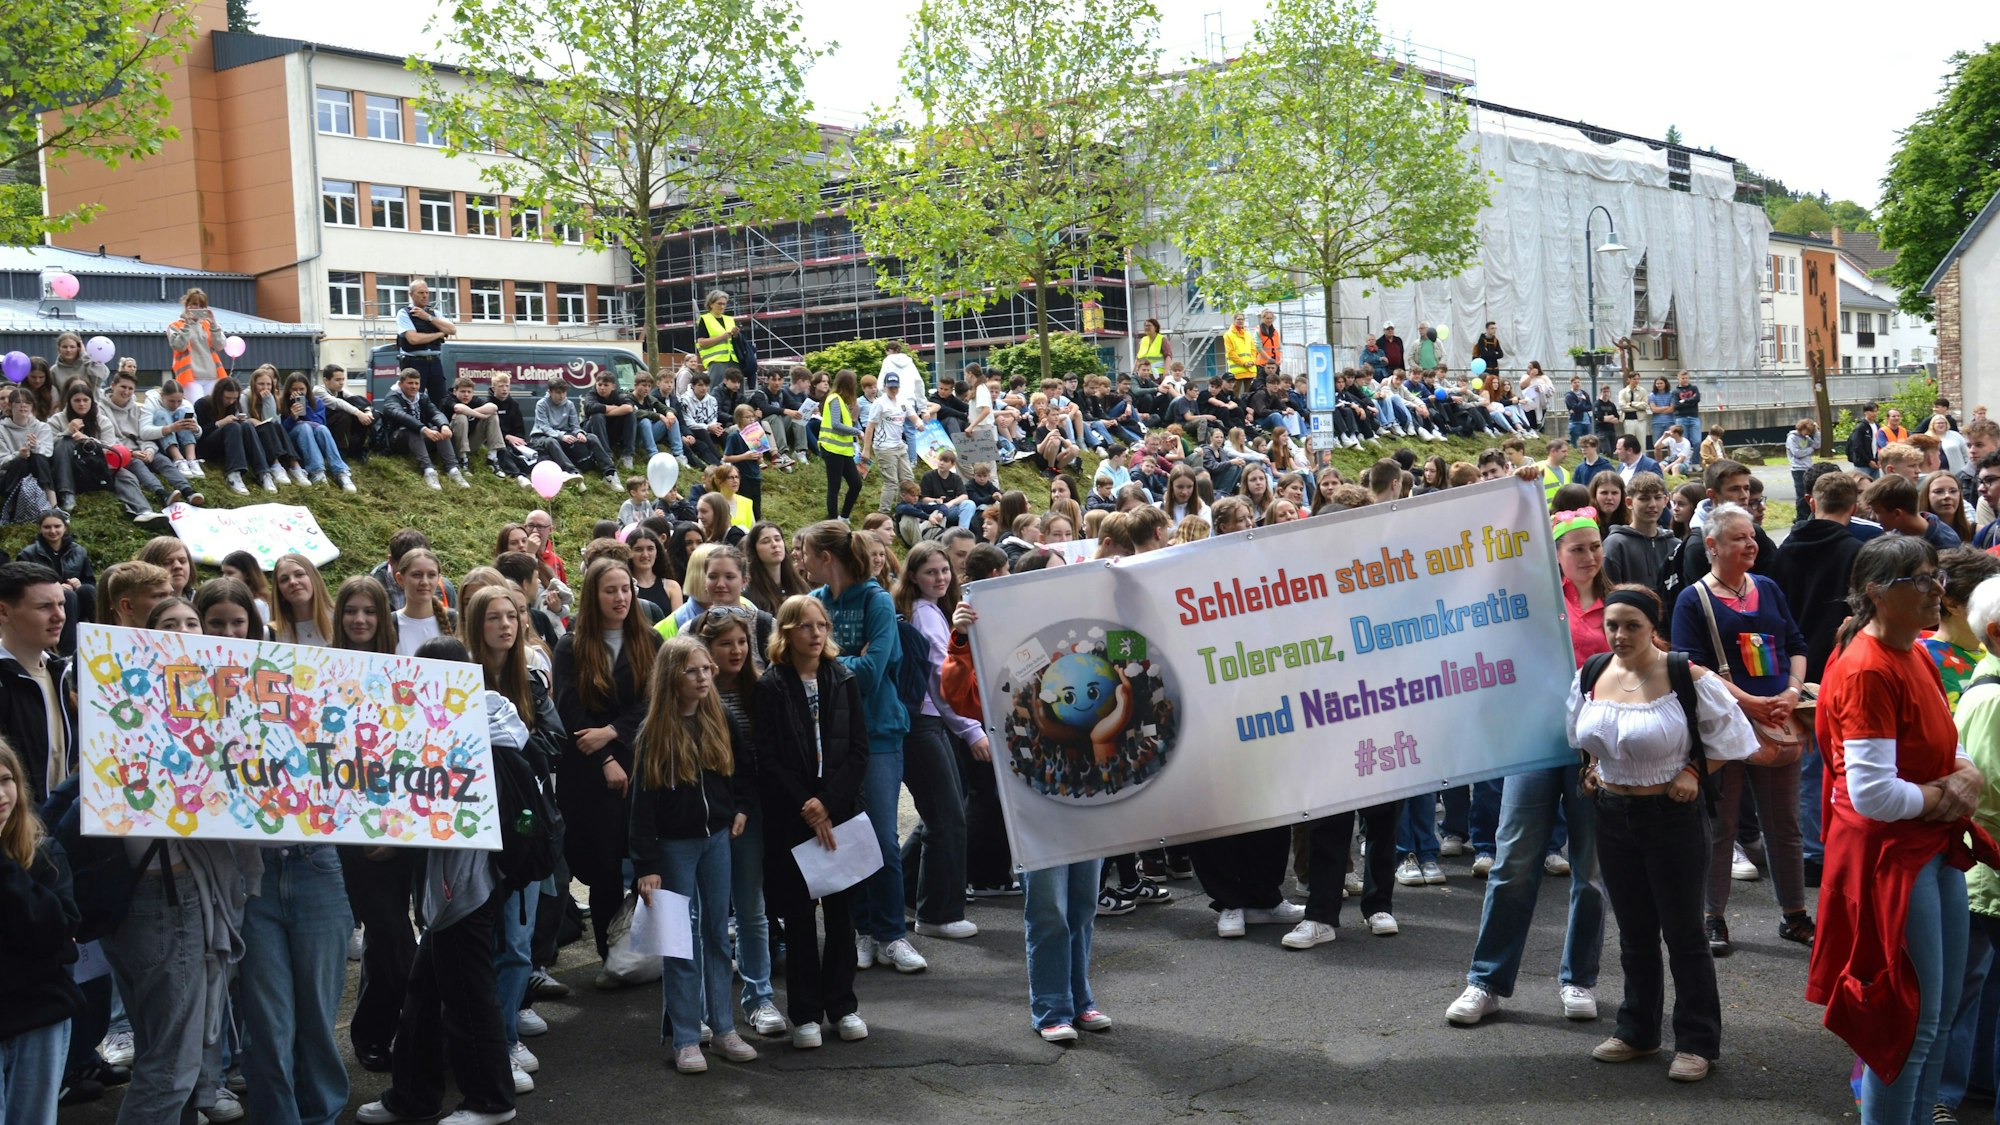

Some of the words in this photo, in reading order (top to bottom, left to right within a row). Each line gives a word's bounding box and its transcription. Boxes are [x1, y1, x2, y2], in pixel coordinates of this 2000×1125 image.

[516, 365, 564, 381] Lehmert
[1175, 569, 1328, 626] Schleiden
[1335, 547, 1418, 594] steht
[1424, 530, 1474, 576] auf
[1482, 525, 1530, 563] für
[1197, 634, 1344, 684] Toleranz,
[1350, 588, 1529, 655] Demokratie
[163, 664, 292, 723] CFS
[1236, 696, 1295, 742] und
[1300, 652, 1516, 728] Nächstenliebe
[220, 741, 287, 789] für
[306, 742, 481, 803] Toleranz
[1354, 731, 1421, 777] #sft
